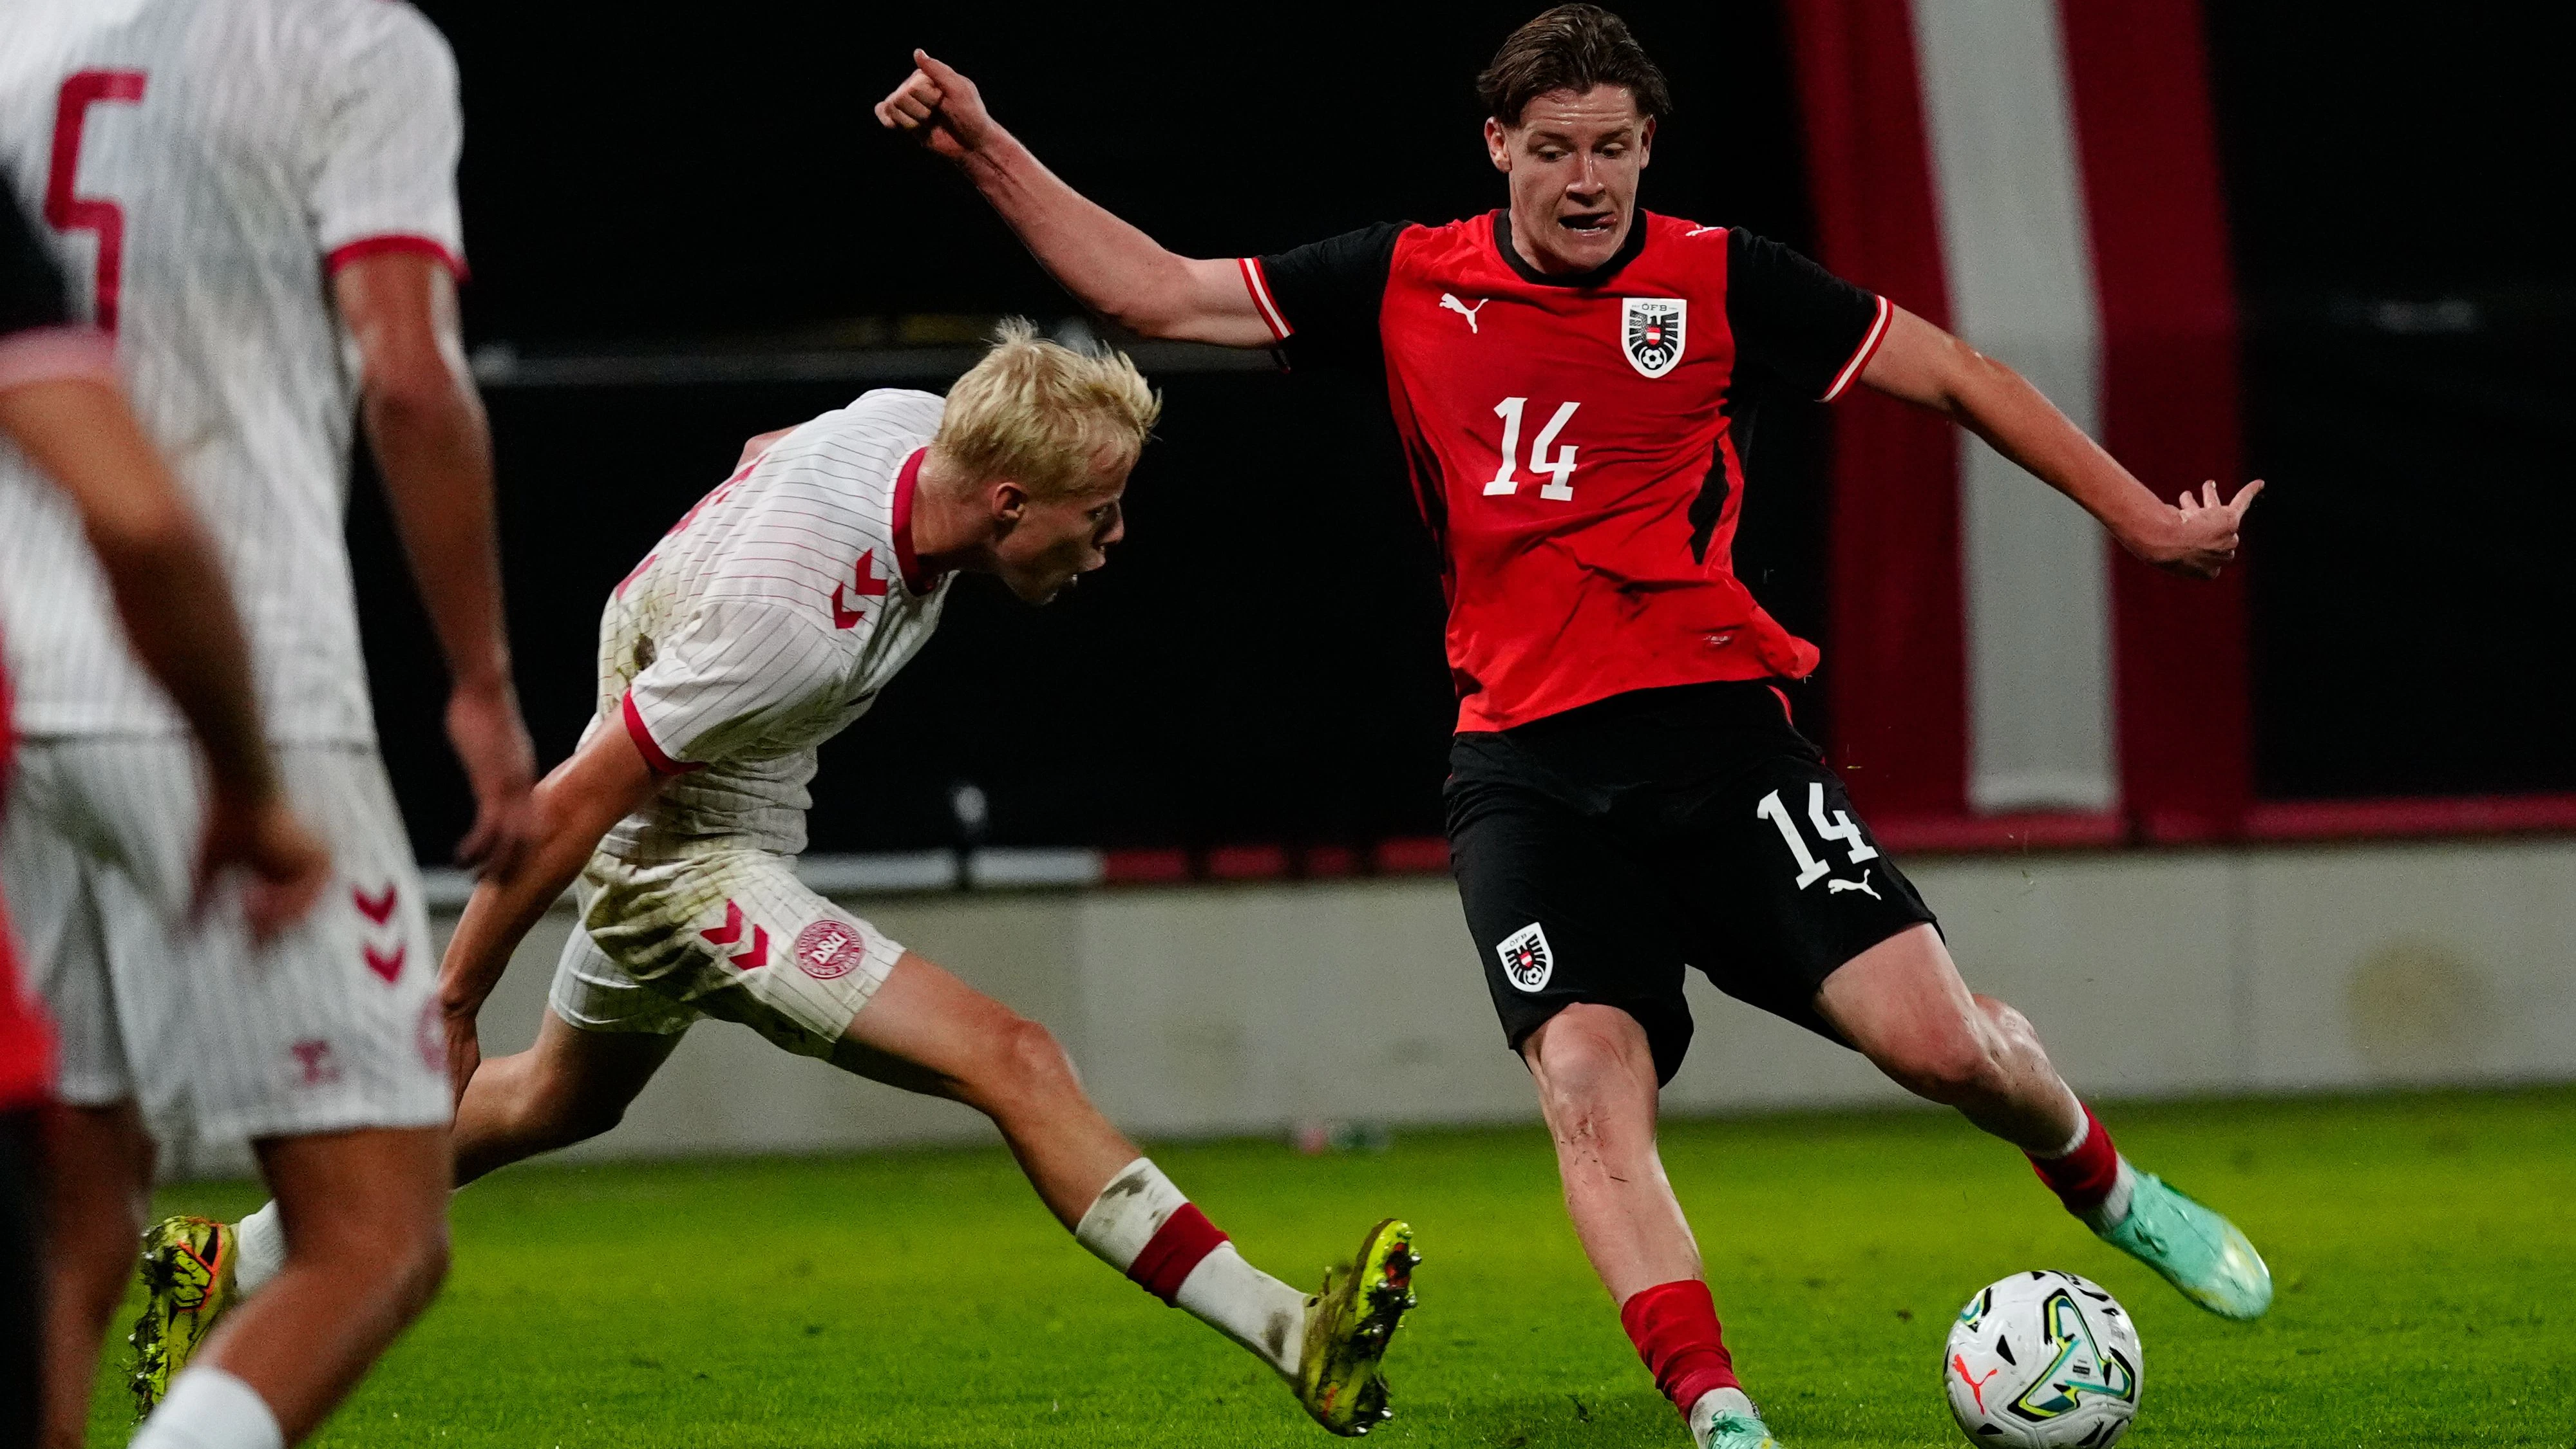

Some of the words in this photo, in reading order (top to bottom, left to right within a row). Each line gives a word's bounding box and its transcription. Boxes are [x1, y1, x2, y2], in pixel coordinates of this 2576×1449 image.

[45, 68, 148, 338] 5
[1642, 303, 1667, 312] ÖFB
[1482, 397, 1581, 501] 14
[1757, 782, 1879, 890] 14
[810, 932, 848, 964] DBU
